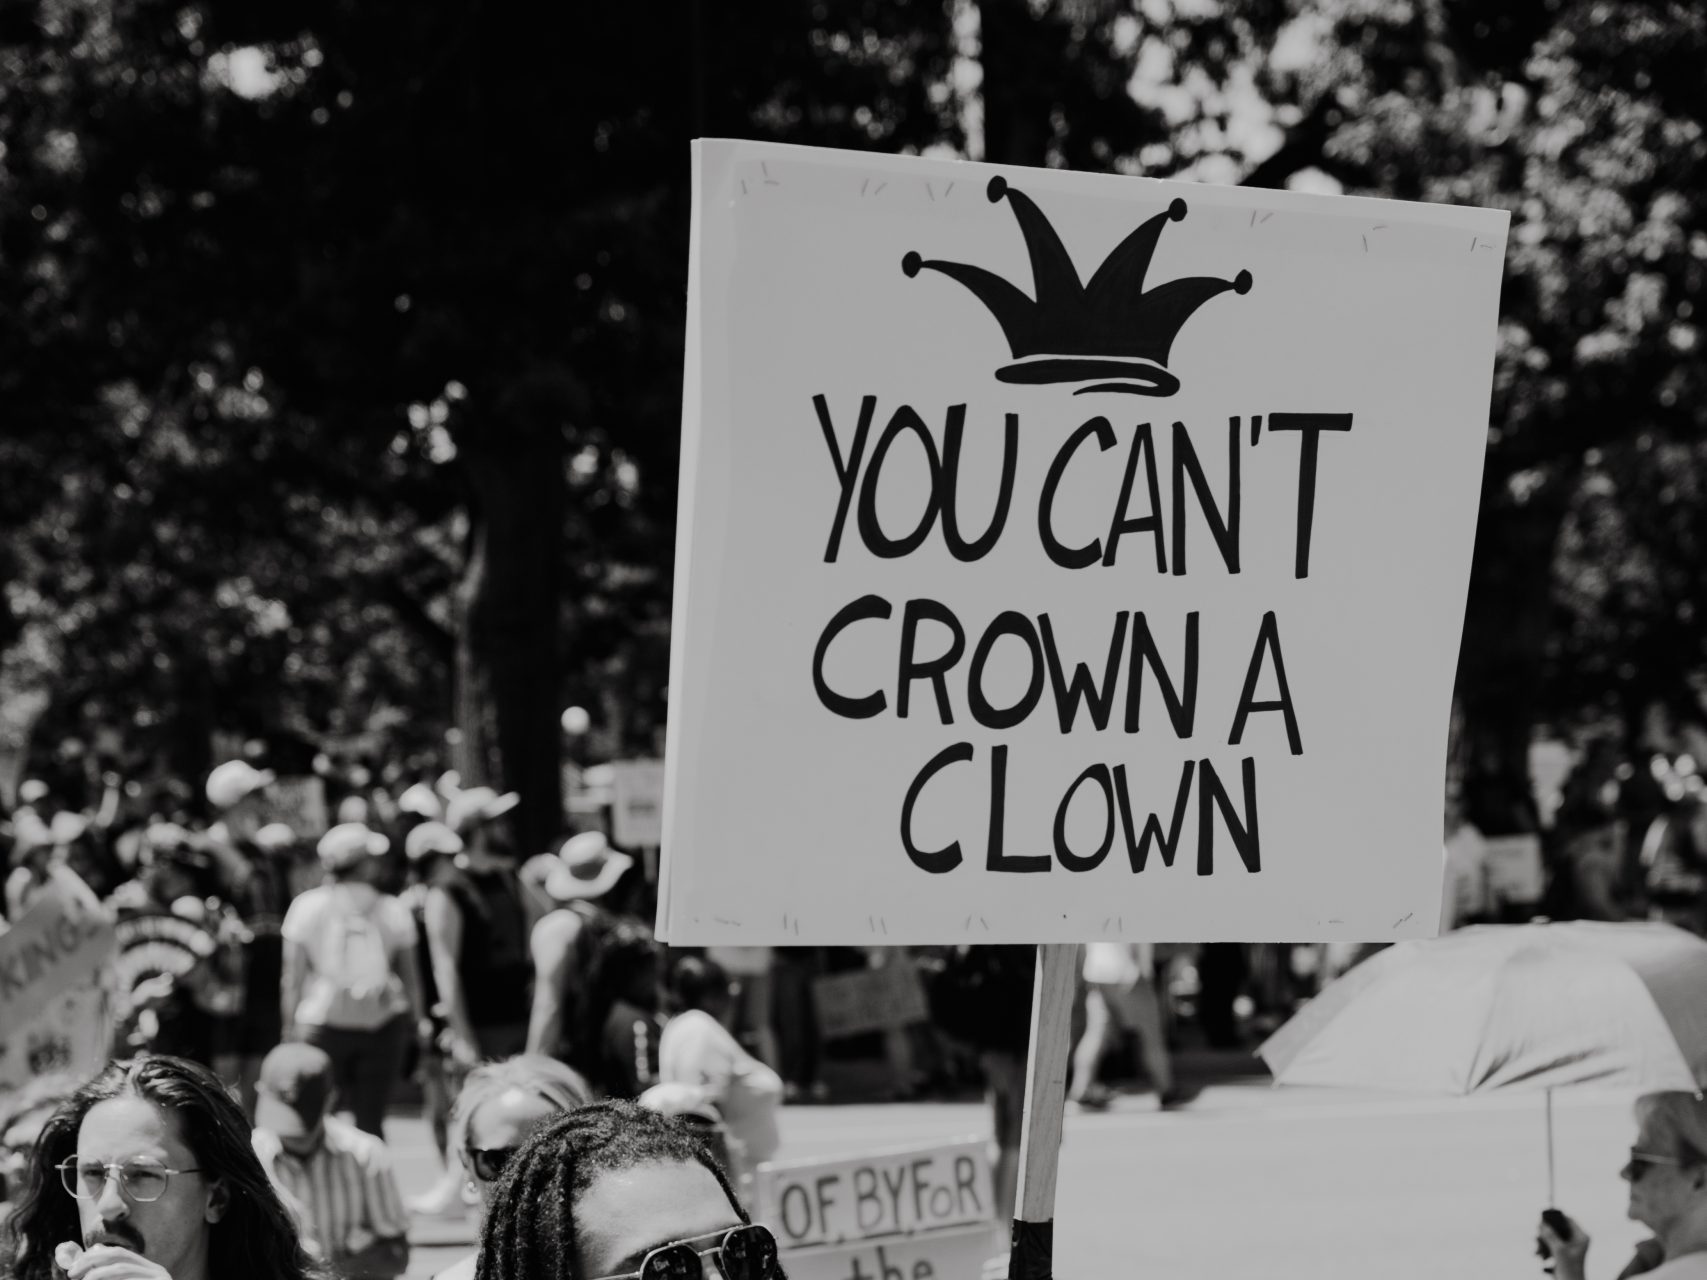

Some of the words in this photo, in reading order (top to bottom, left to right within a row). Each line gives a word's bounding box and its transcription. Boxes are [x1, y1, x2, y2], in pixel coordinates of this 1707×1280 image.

[812, 393, 1019, 564] YOU
[1037, 412, 1354, 580] CAN'T
[812, 594, 1200, 739] CROWN
[1227, 610, 1304, 756] A
[900, 741, 1262, 877] CLOWN
